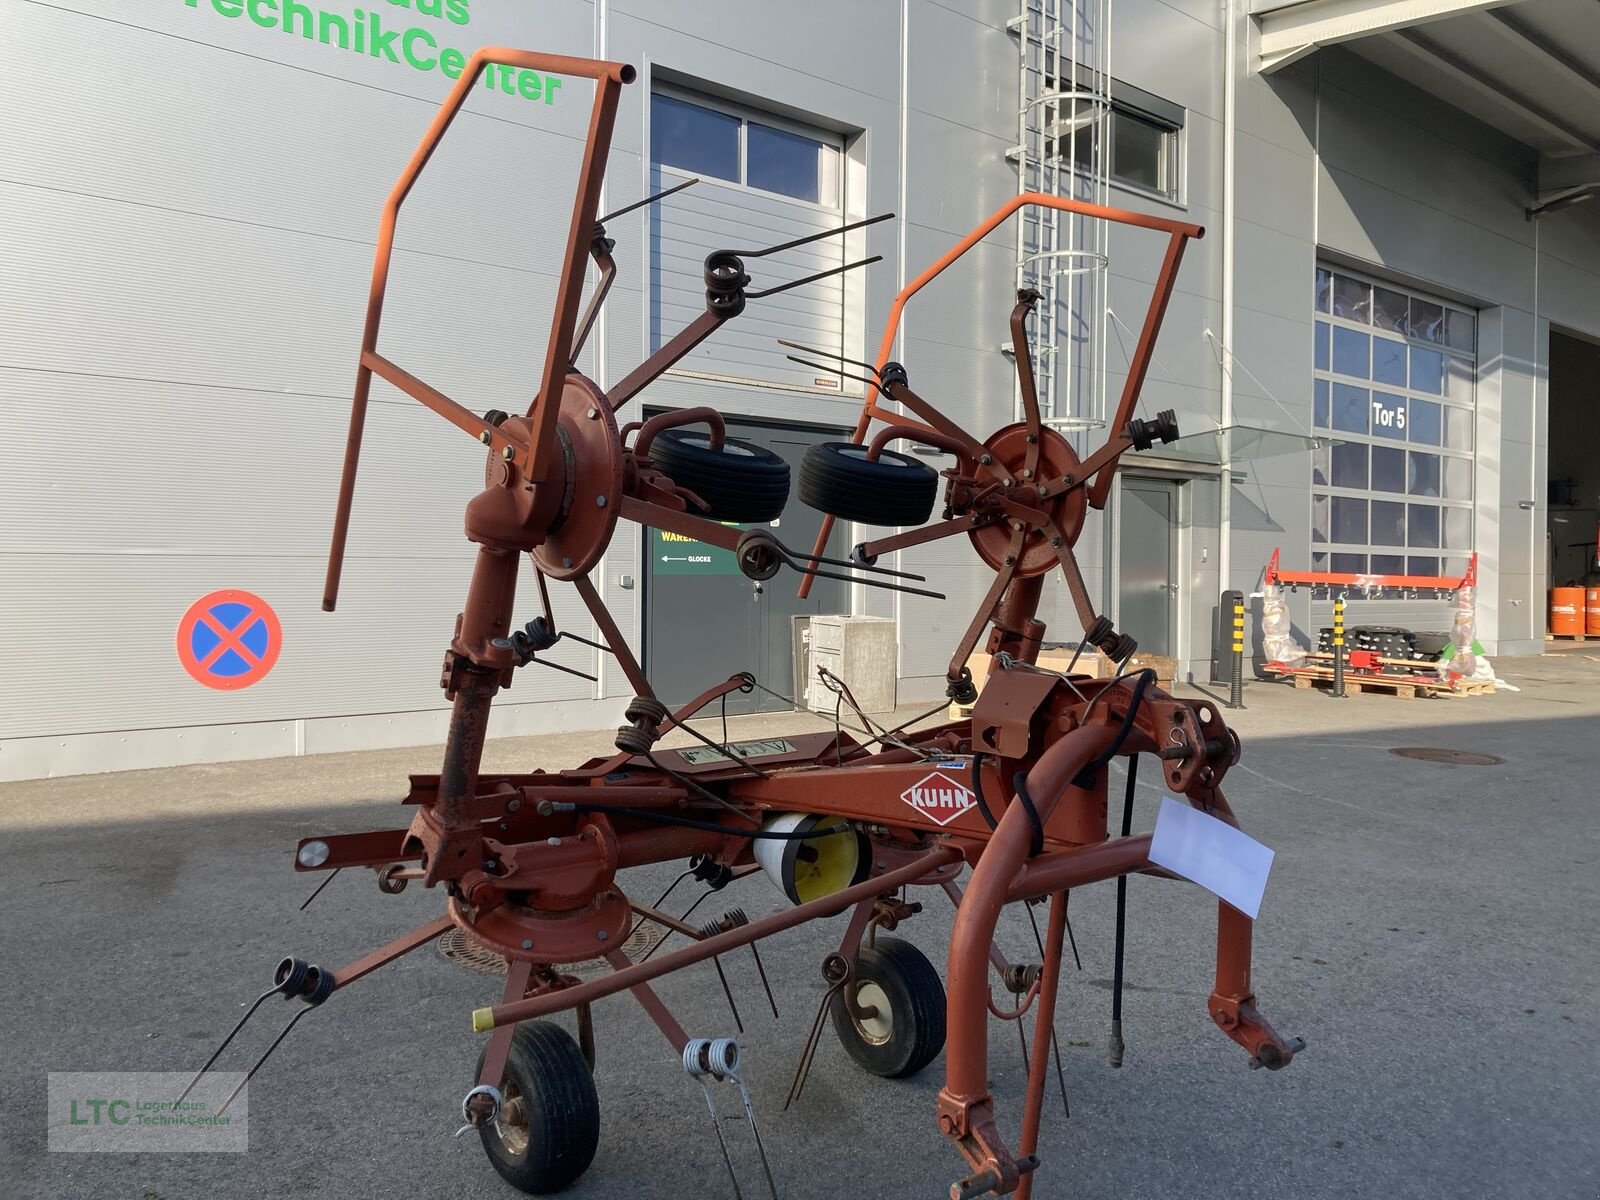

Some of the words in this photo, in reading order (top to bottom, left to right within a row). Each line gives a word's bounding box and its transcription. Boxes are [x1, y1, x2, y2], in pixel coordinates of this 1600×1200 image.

[1373, 402, 1394, 427] Tor
[1396, 407, 1405, 429] 5
[687, 555, 712, 563] GLOCKE
[911, 788, 969, 808] KUHN
